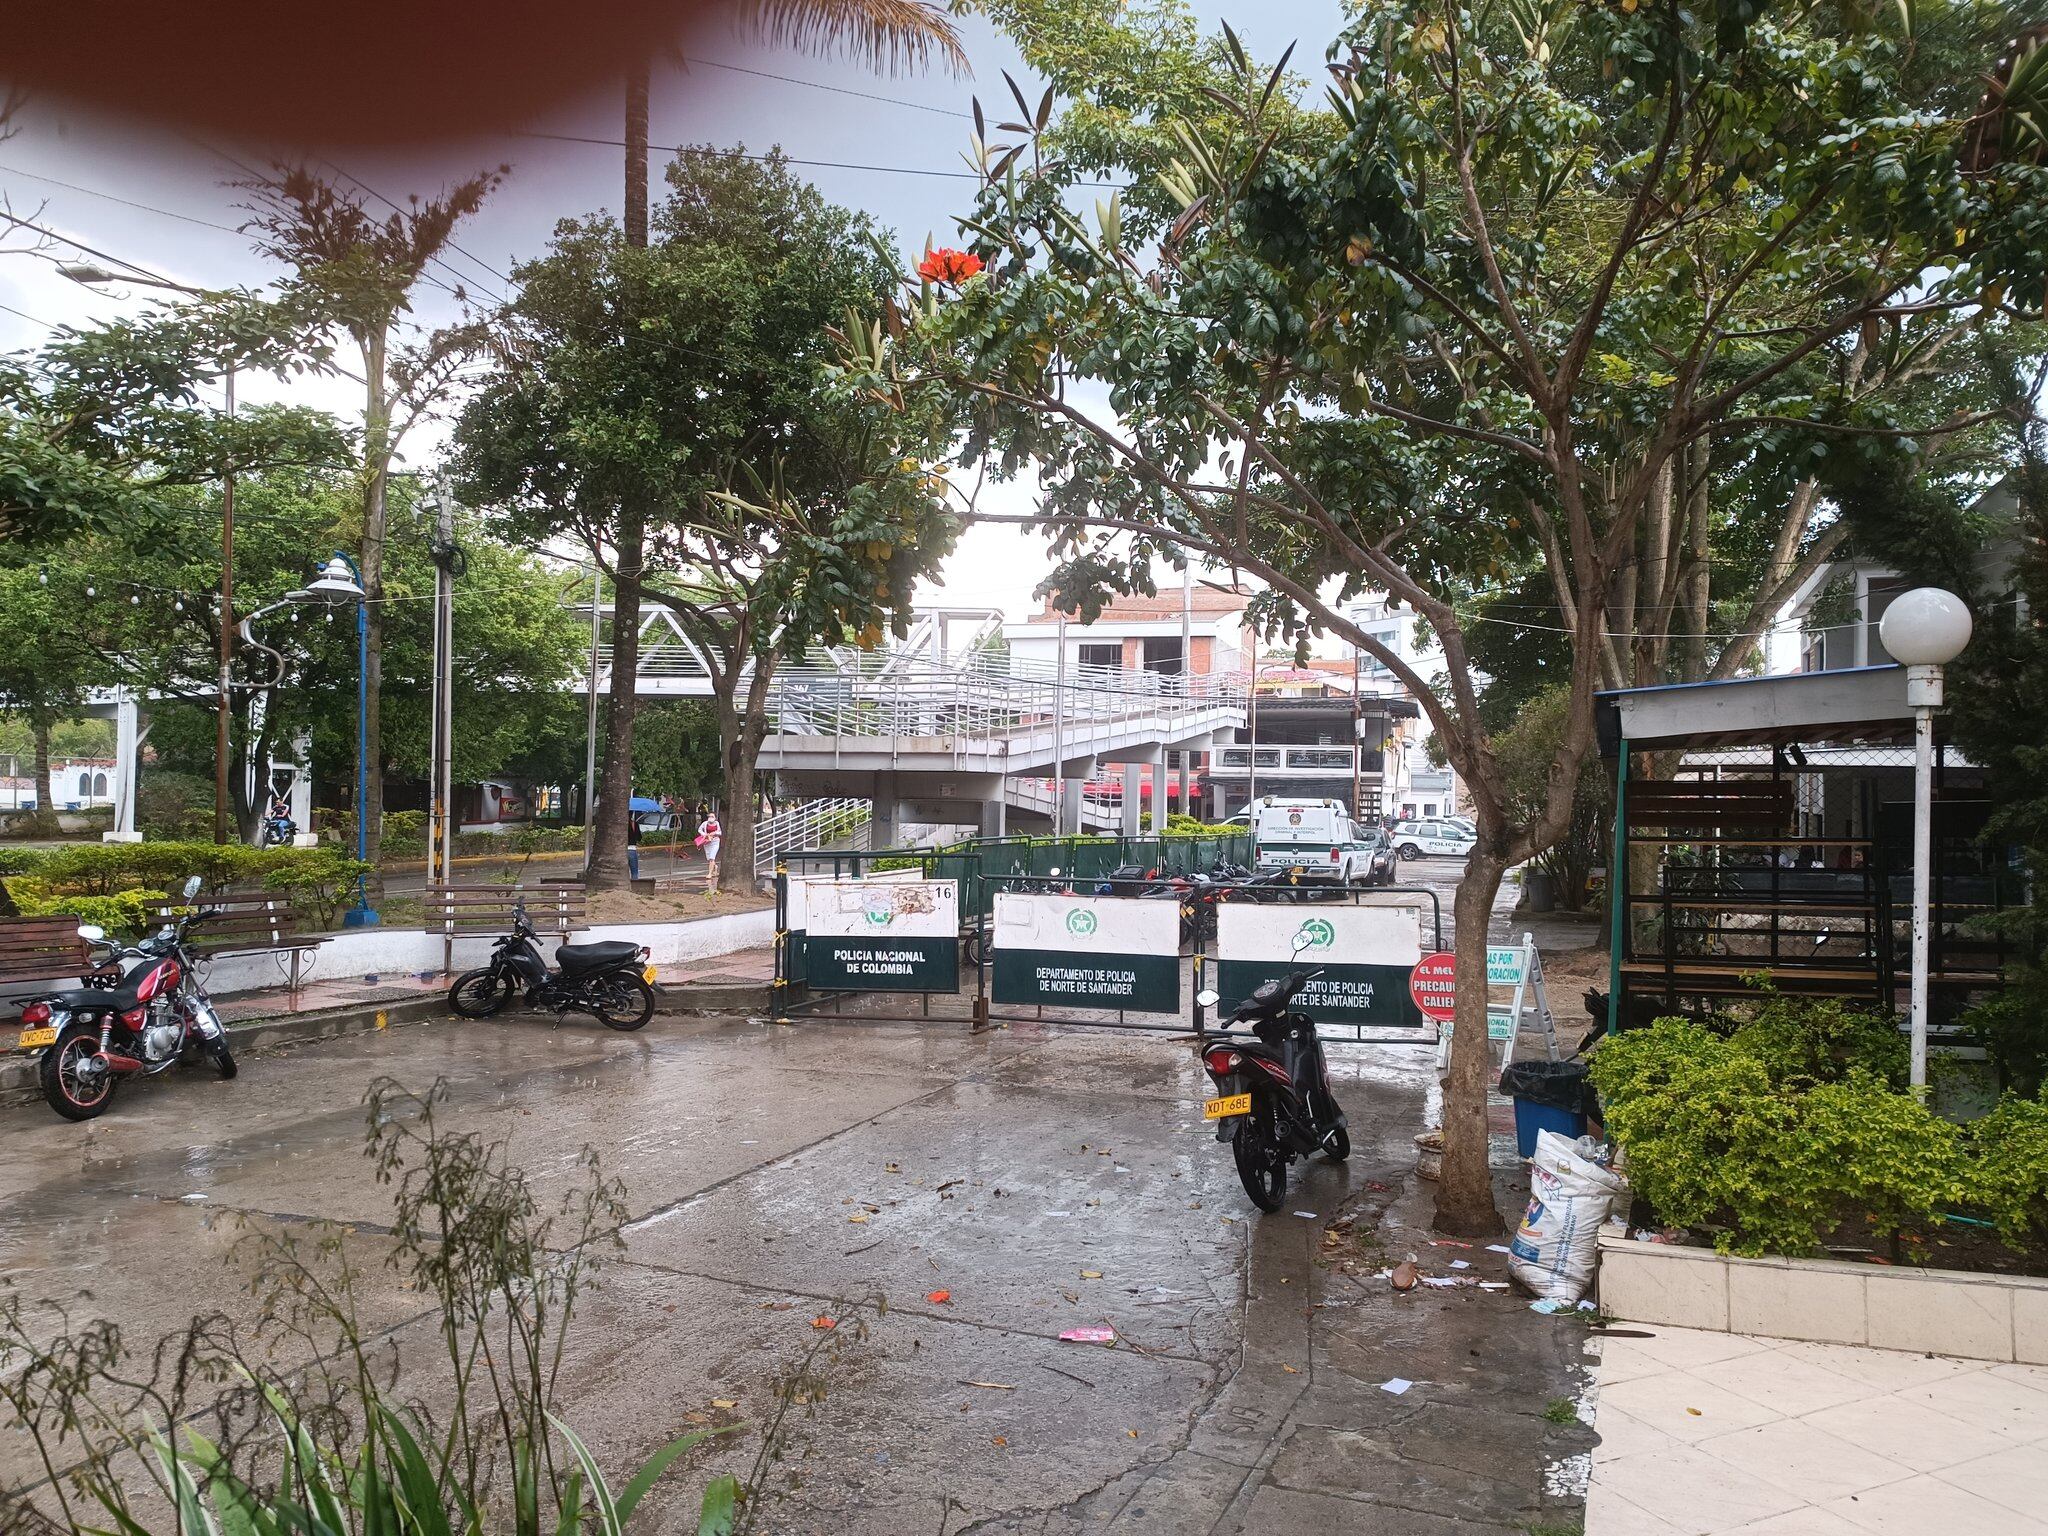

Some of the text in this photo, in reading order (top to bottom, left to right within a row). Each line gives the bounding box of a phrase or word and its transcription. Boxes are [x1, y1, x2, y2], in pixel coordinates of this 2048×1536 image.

[935, 886, 952, 899] 16
[833, 949, 926, 962] POLICIA NACIONAL
[1498, 953, 1514, 965] POR
[846, 963, 914, 975] DE COLOMBIA
[1036, 967, 1136, 983] DEPARTAMENTO DE POLICIA
[1419, 965, 1431, 975] EL
[1039, 980, 1133, 995] DE NORTE DE SANTANDER
[1329, 981, 1341, 994] DE
[1342, 982, 1374, 995] POLICIA
[1309, 994, 1320, 1006] DE
[1321, 995, 1371, 1009] SANTANDER
